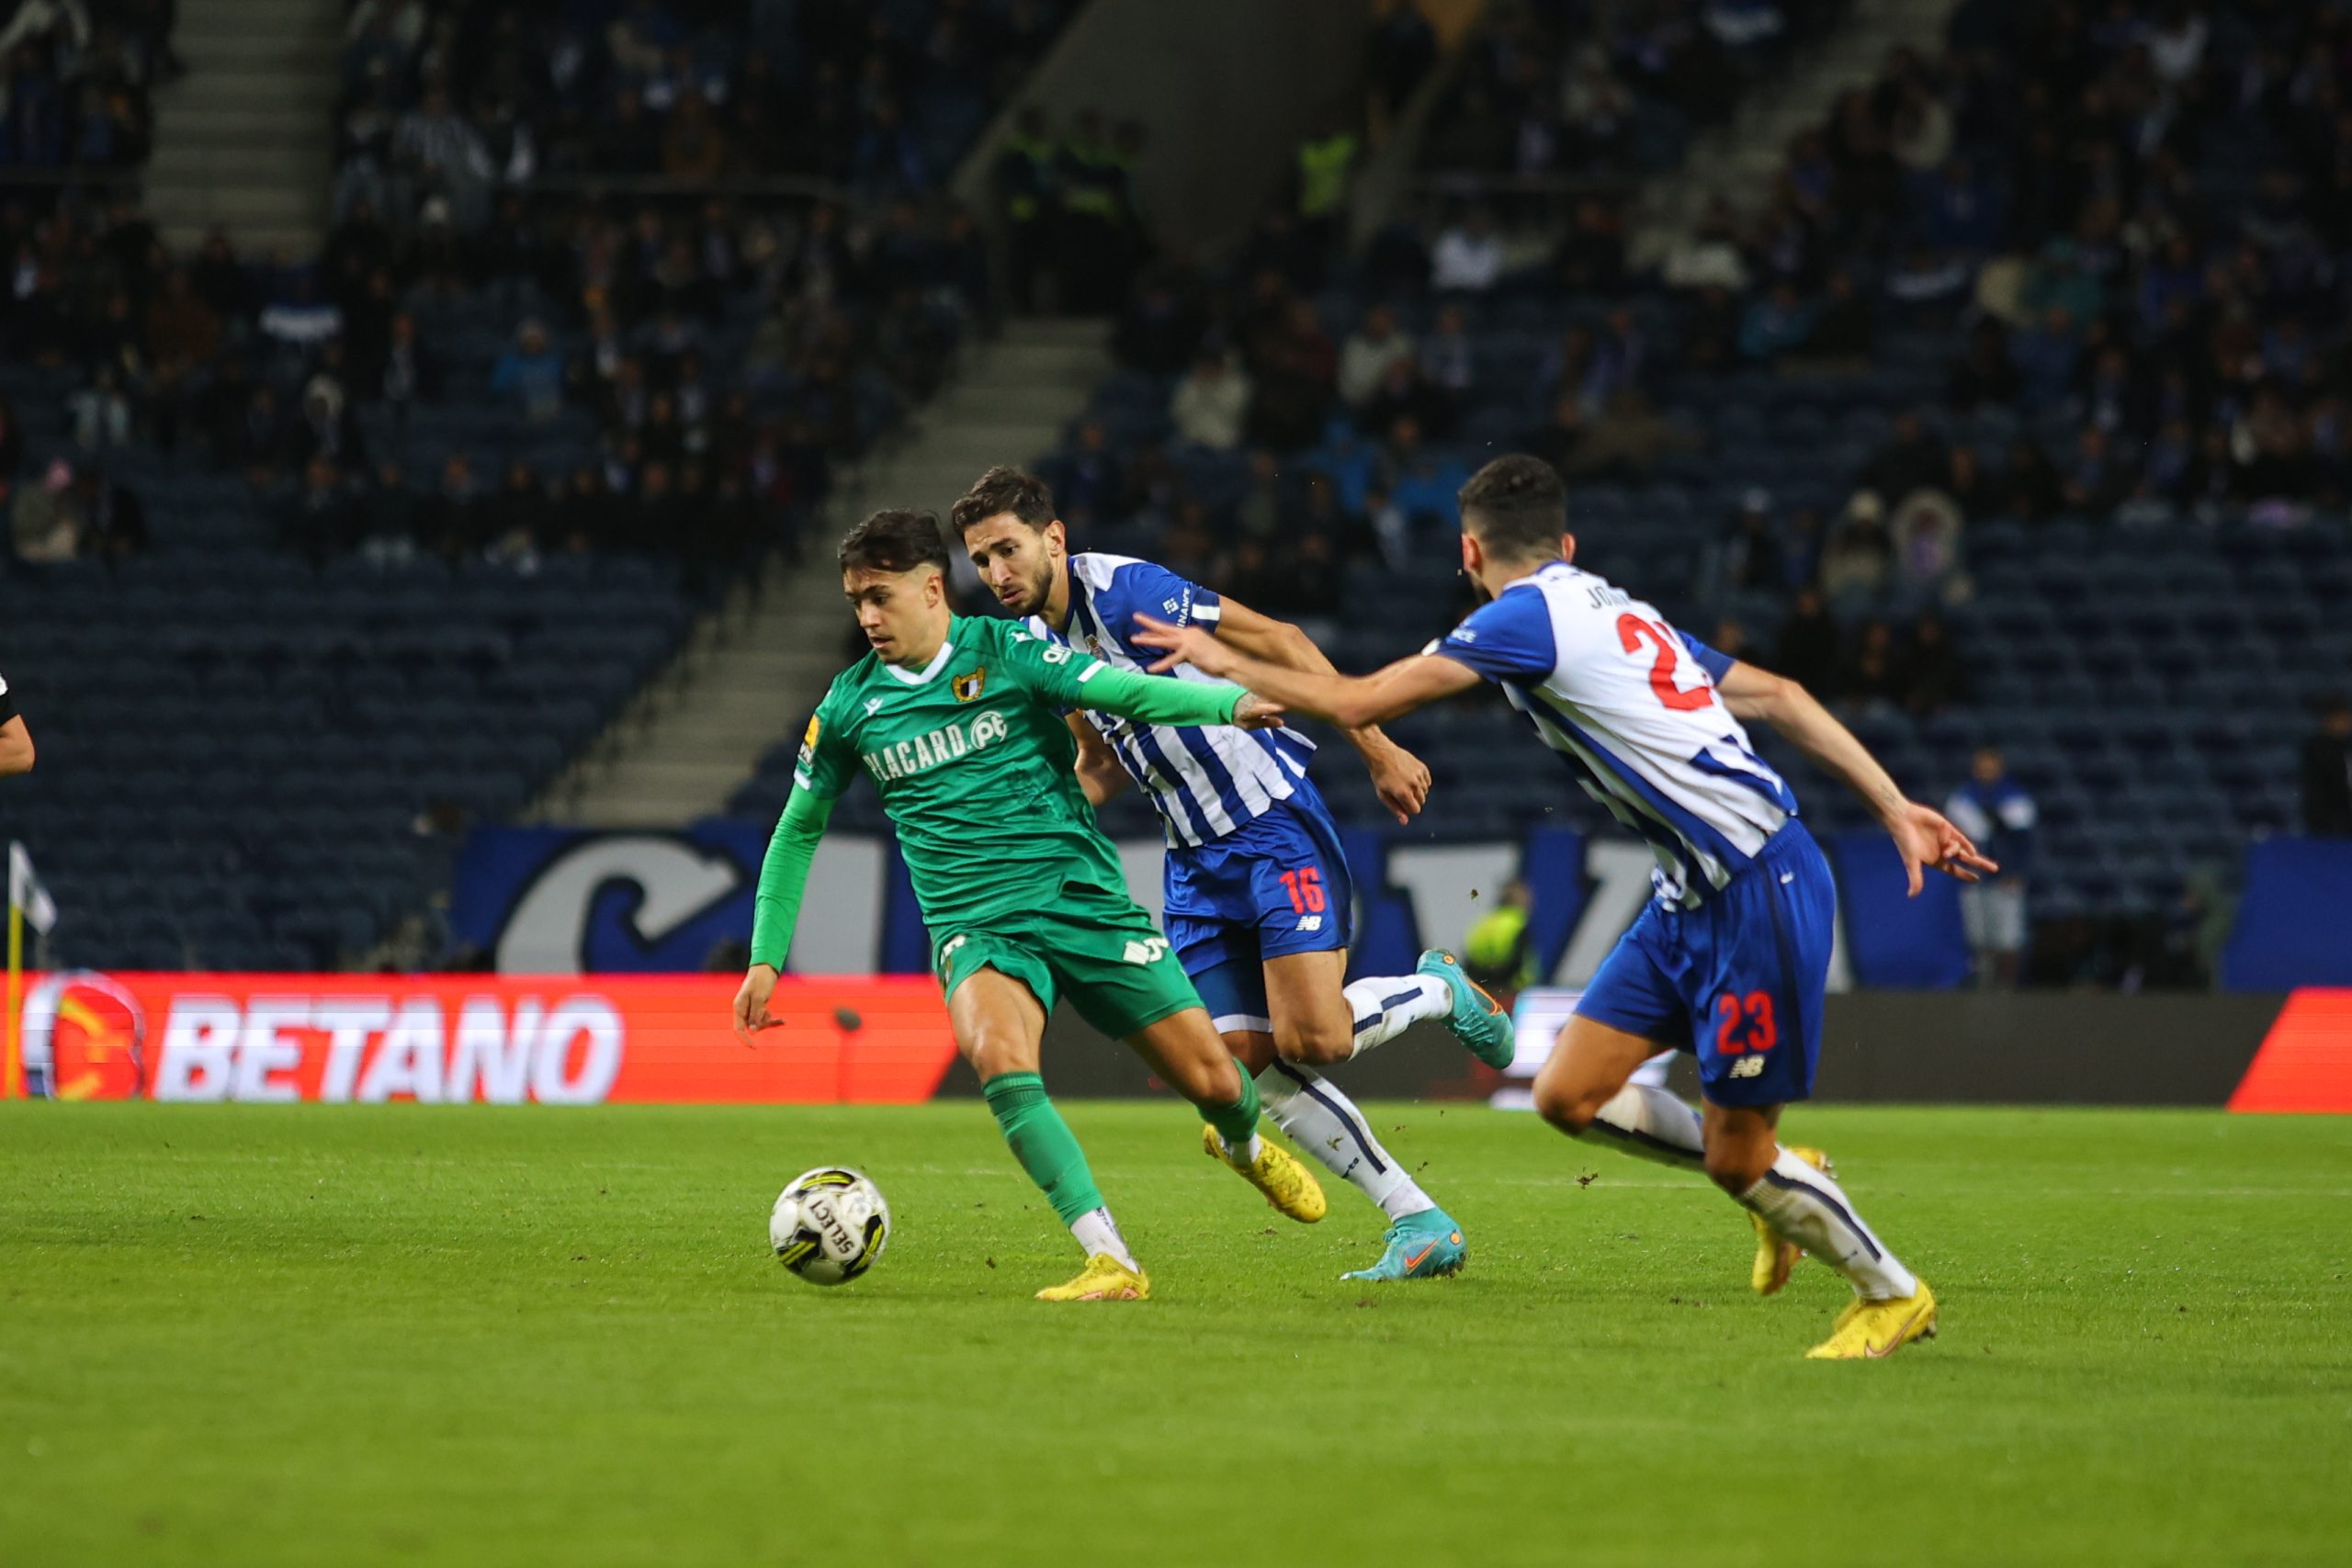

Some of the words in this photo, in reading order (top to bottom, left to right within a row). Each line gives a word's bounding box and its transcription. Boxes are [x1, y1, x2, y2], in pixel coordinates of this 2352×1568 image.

[1616, 613, 1714, 712] 2
[1278, 866, 1327, 915] 16
[1295, 915, 1323, 931] NB
[153, 995, 626, 1102] BETANO
[1717, 990, 1777, 1055] 23
[1728, 1054, 1765, 1078] NB
[808, 1199, 855, 1255] SELECT
